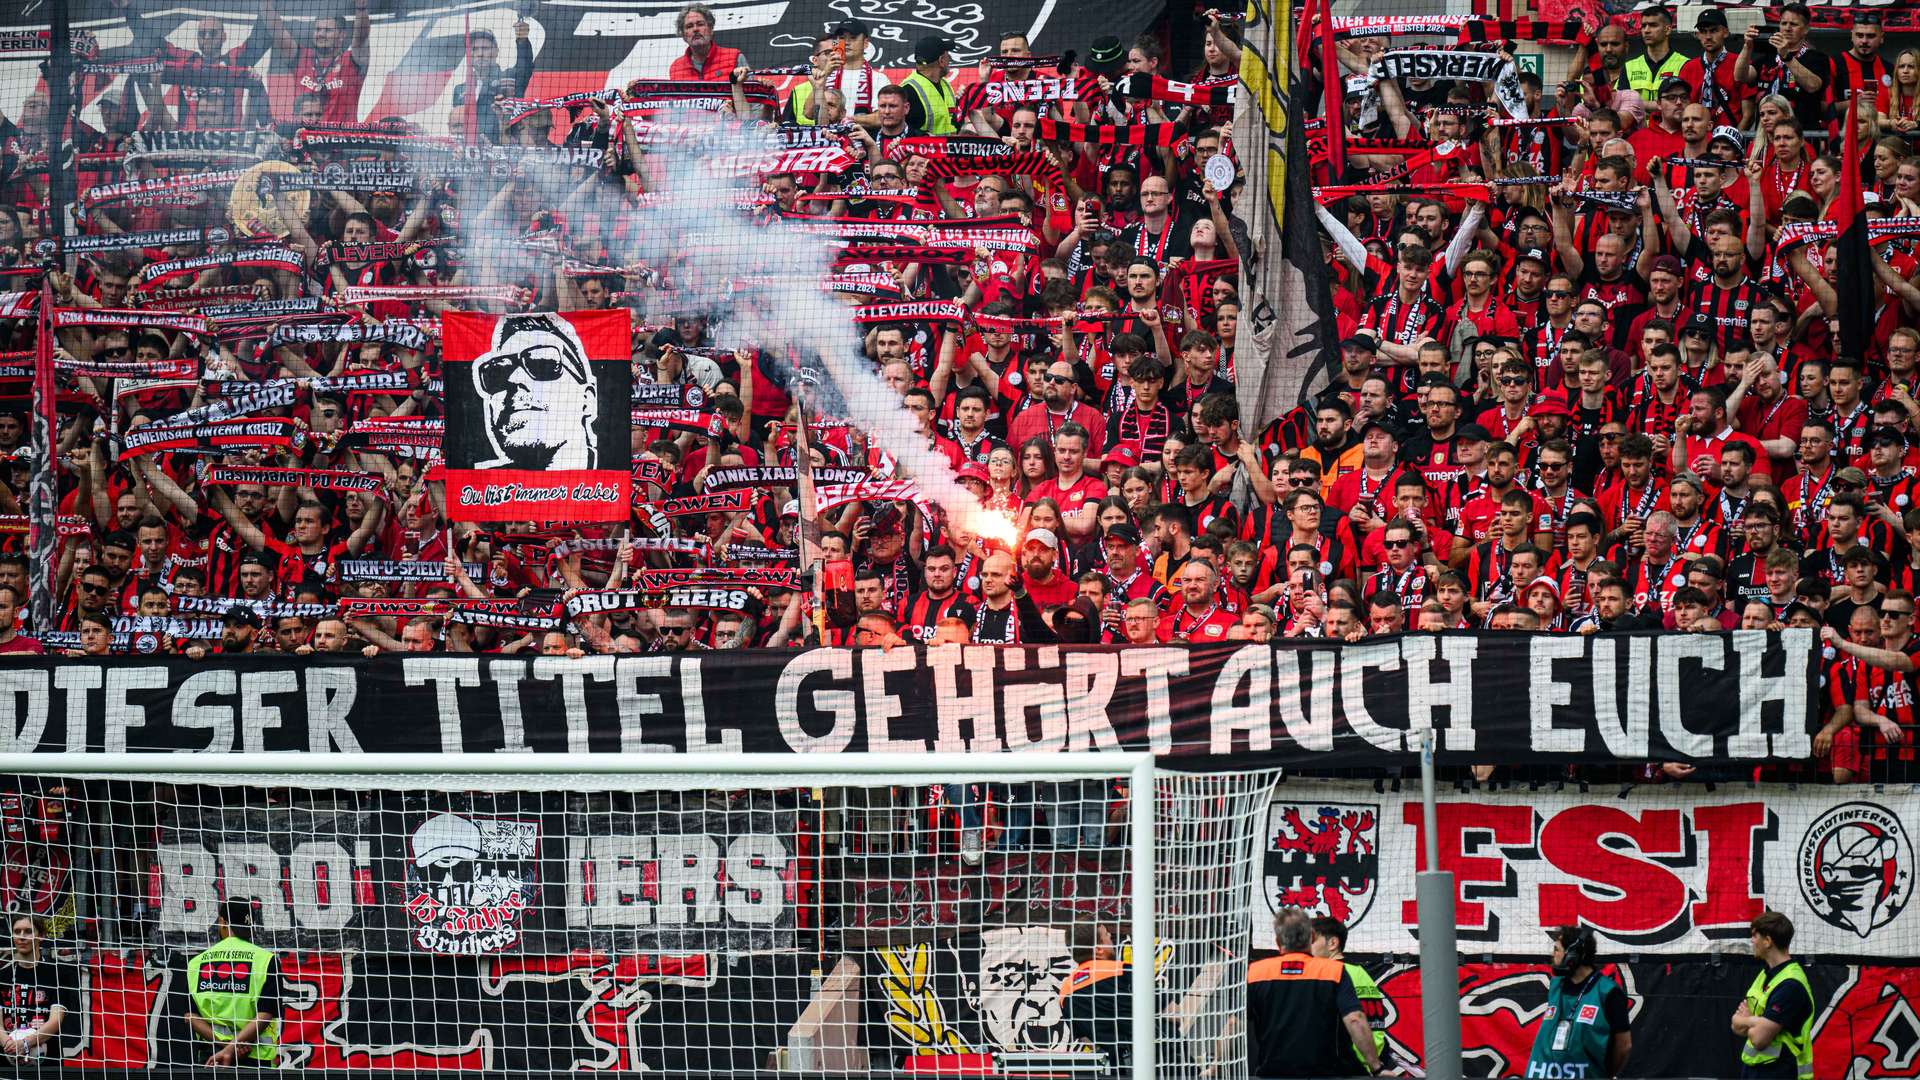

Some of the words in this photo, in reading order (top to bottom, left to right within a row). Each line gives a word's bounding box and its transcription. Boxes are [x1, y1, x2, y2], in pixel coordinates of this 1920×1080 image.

[1331, 16, 1364, 30] AYER
[1368, 16, 1385, 25] 04
[1390, 14, 1480, 26] LEVERKUSEN
[1351, 25, 1392, 35] DEUTSCHER
[1394, 24, 1424, 33] MEISTER
[1427, 24, 1445, 32] 2024
[0, 39, 48, 50] EREIN
[1375, 53, 1506, 80] WERKSELF
[985, 78, 1080, 104] TEENS
[623, 101, 669, 112] EINSAM
[672, 98, 722, 111] UNTERM
[550, 148, 604, 168] JAHR
[919, 144, 937, 154] 04
[90, 180, 142, 200] BAYER
[147, 178, 165, 190] 04
[841, 223, 926, 236] LEVERKUSE
[968, 229, 1037, 243] LEVERKU
[1778, 222, 1814, 246] AYER
[928, 240, 971, 249] DEUTSCHER
[973, 240, 1005, 250] MEISTER
[1007, 242, 1026, 252] 2024
[184, 253, 233, 268] UNTERM
[146, 261, 182, 281] KREUZ
[857, 284, 876, 294] 2024
[58, 312, 83, 324] 2024
[870, 302, 965, 319] LEVERKUSEN
[1714, 317, 1748, 328] menia
[334, 371, 407, 391] JAHRE
[632, 384, 680, 398] VEREIN
[231, 387, 296, 417] JAHRE
[651, 419, 670, 428] 2024
[125, 428, 194, 450] GEMEINSAM
[196, 423, 243, 438] UNTERM
[245, 422, 283, 436] KREUZ
[213, 468, 307, 488] Leverkusen
[310, 472, 331, 488] 04
[334, 472, 382, 491] Bayer
[706, 467, 758, 488] DANKE
[460, 486, 483, 505] Du
[485, 484, 514, 506] bist
[515, 483, 567, 502] immer
[572, 482, 620, 504] dabei
[340, 559, 483, 579] TURN-U-SPIELVEIN
[1738, 586, 1771, 596] Barme
[457, 598, 556, 617] LÖWN
[184, 617, 226, 640] JAH
[0, 665, 366, 755] DIESER
[403, 655, 744, 755] TITEL
[1209, 636, 1479, 755] AUCH
[1529, 628, 1814, 759] EUCH
[1803, 808, 1899, 907] FARBENSTADTINFERNO
[1401, 801, 1768, 938] FSI
[444, 890, 527, 935] Jahre
[416, 923, 517, 955] Brothers
[202, 951, 225, 961] SECURITY
[231, 950, 255, 961] SERVICE
[199, 980, 247, 991] Securitas
[19, 983, 29, 1028] MEISTE
[1527, 1060, 1589, 1079] HOST
